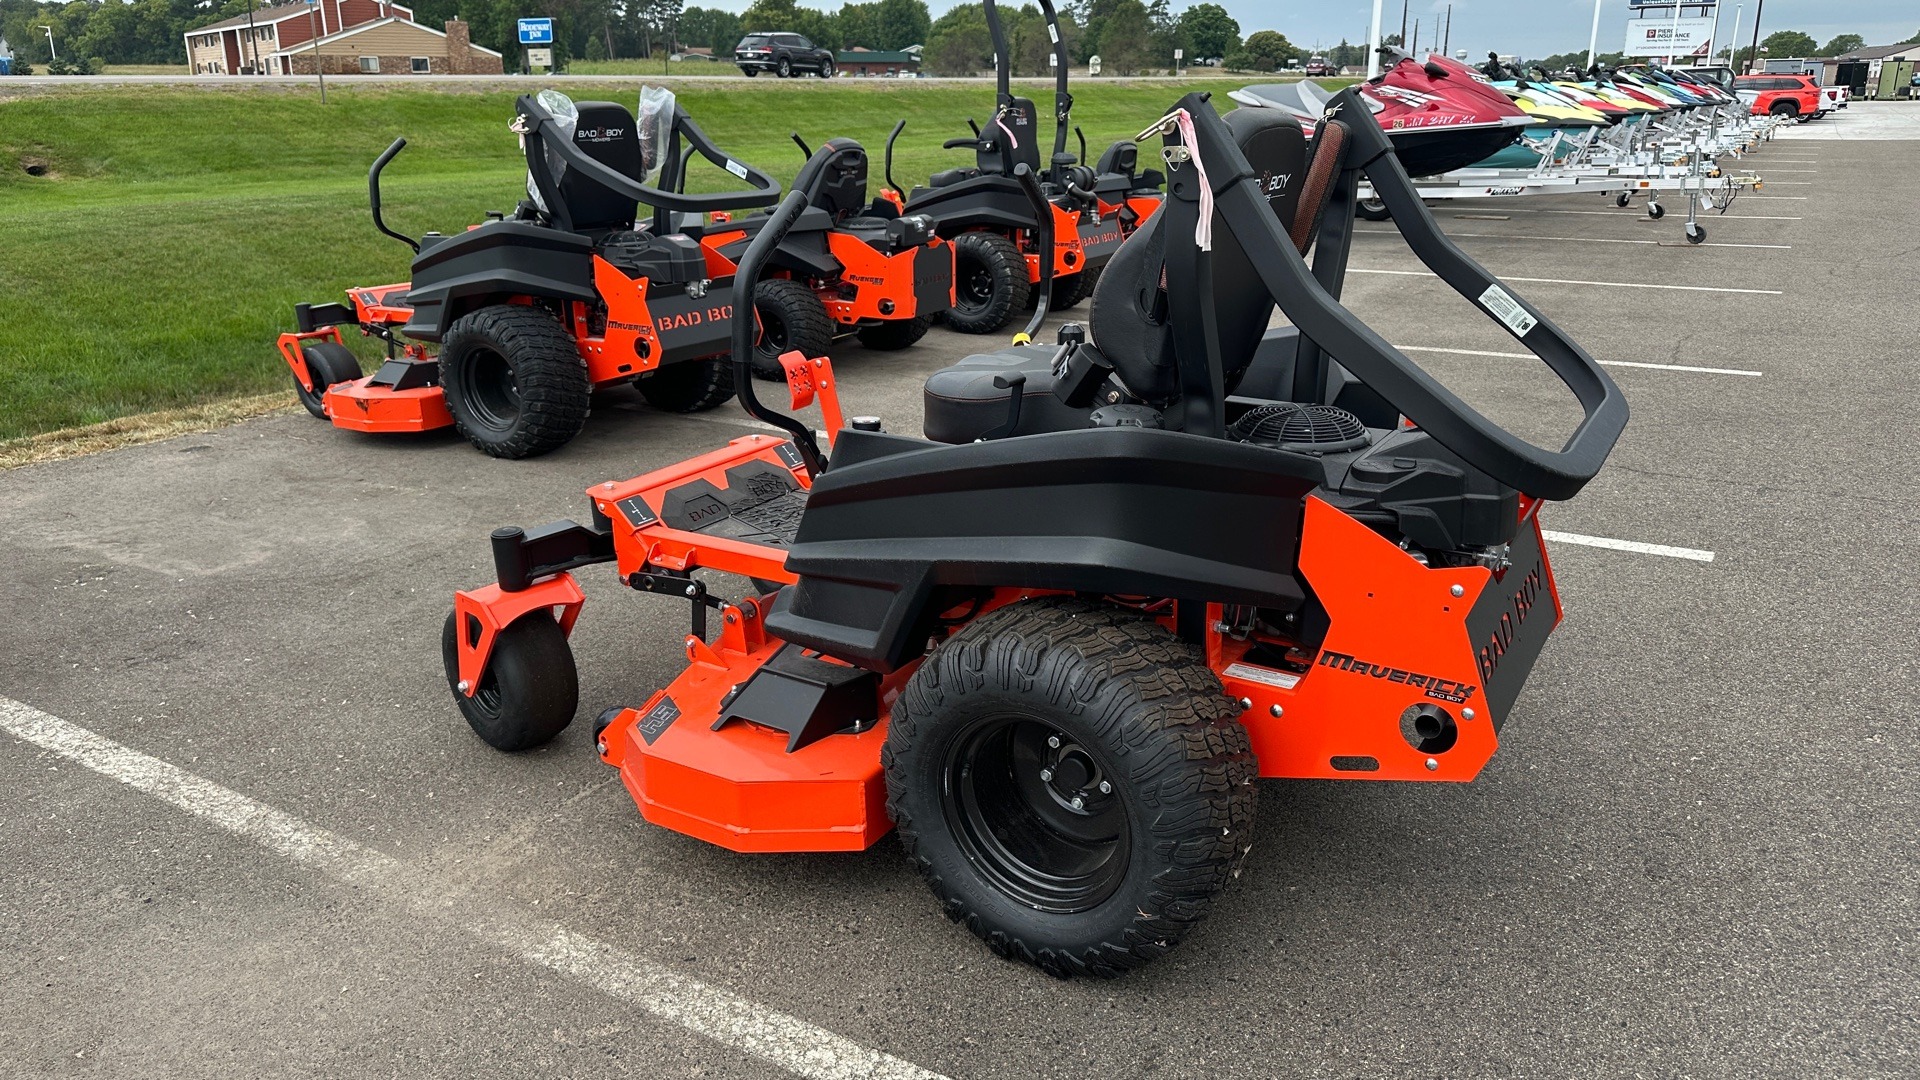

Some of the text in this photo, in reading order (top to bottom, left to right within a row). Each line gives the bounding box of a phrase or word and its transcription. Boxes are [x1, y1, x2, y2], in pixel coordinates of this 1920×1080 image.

[529, 31, 542, 40] INN
[1393, 119, 1403, 128] 26
[578, 128, 624, 138] BAD BOY
[1269, 173, 1292, 191] BOY
[1081, 231, 1118, 247] BAD BOY
[608, 321, 652, 333] MAVERICK
[658, 311, 702, 331] BAD
[1478, 560, 1542, 686] BAD BOY
[1318, 650, 1477, 698] MAVERICK
[1428, 691, 1463, 703] BAD BOY
[639, 705, 677, 734] 54
